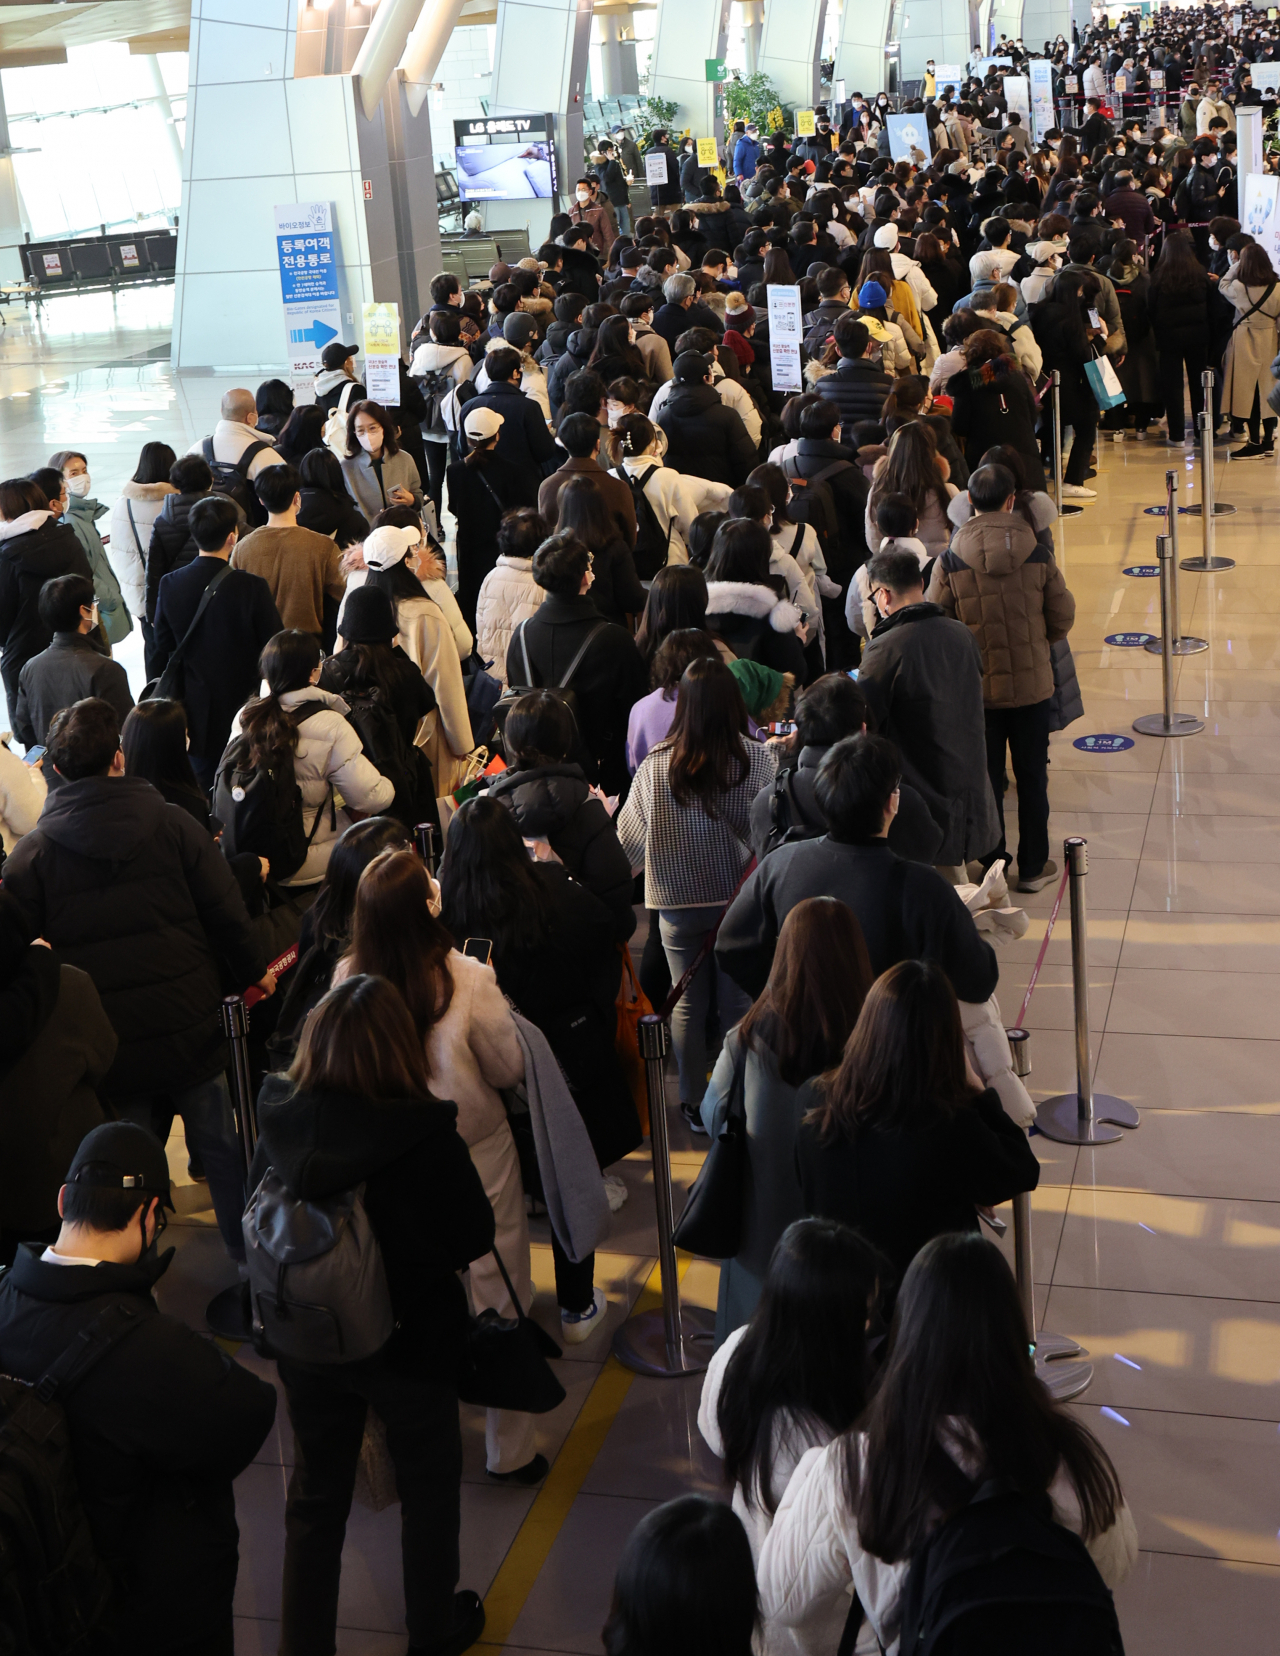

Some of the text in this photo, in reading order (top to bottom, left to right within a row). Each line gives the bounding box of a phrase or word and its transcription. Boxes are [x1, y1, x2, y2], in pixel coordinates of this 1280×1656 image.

[469, 123, 484, 133] LG
[516, 120, 530, 130] TV
[279, 221, 311, 230] 바이오정보
[316, 216, 322, 224] 손
[281, 237, 330, 253] 등록여객
[283, 253, 332, 268] 전용통로
[294, 362, 315, 370] KAC
